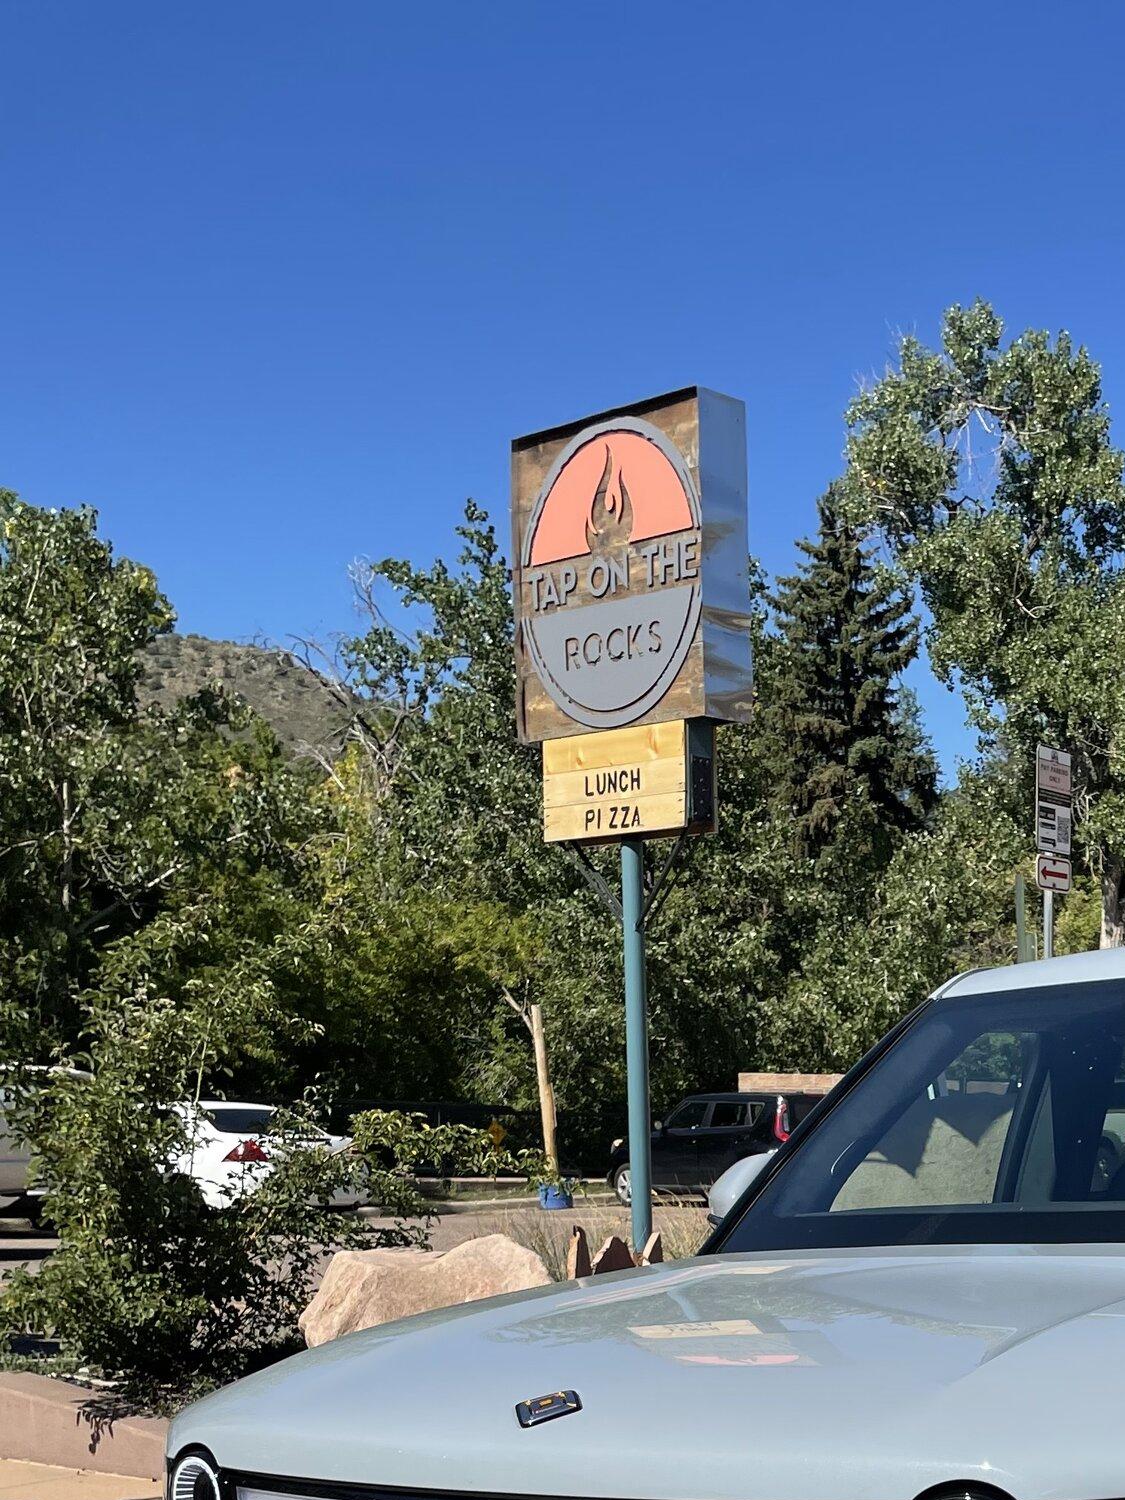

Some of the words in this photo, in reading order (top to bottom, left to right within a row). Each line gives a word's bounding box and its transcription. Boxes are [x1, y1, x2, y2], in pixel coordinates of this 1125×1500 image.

[528, 564, 577, 611] TAP
[586, 552, 629, 598] ON
[642, 536, 698, 587] THE
[565, 620, 662, 671] ROCKS
[584, 767, 641, 797] LUNCH
[585, 805, 642, 831] PIZZA
